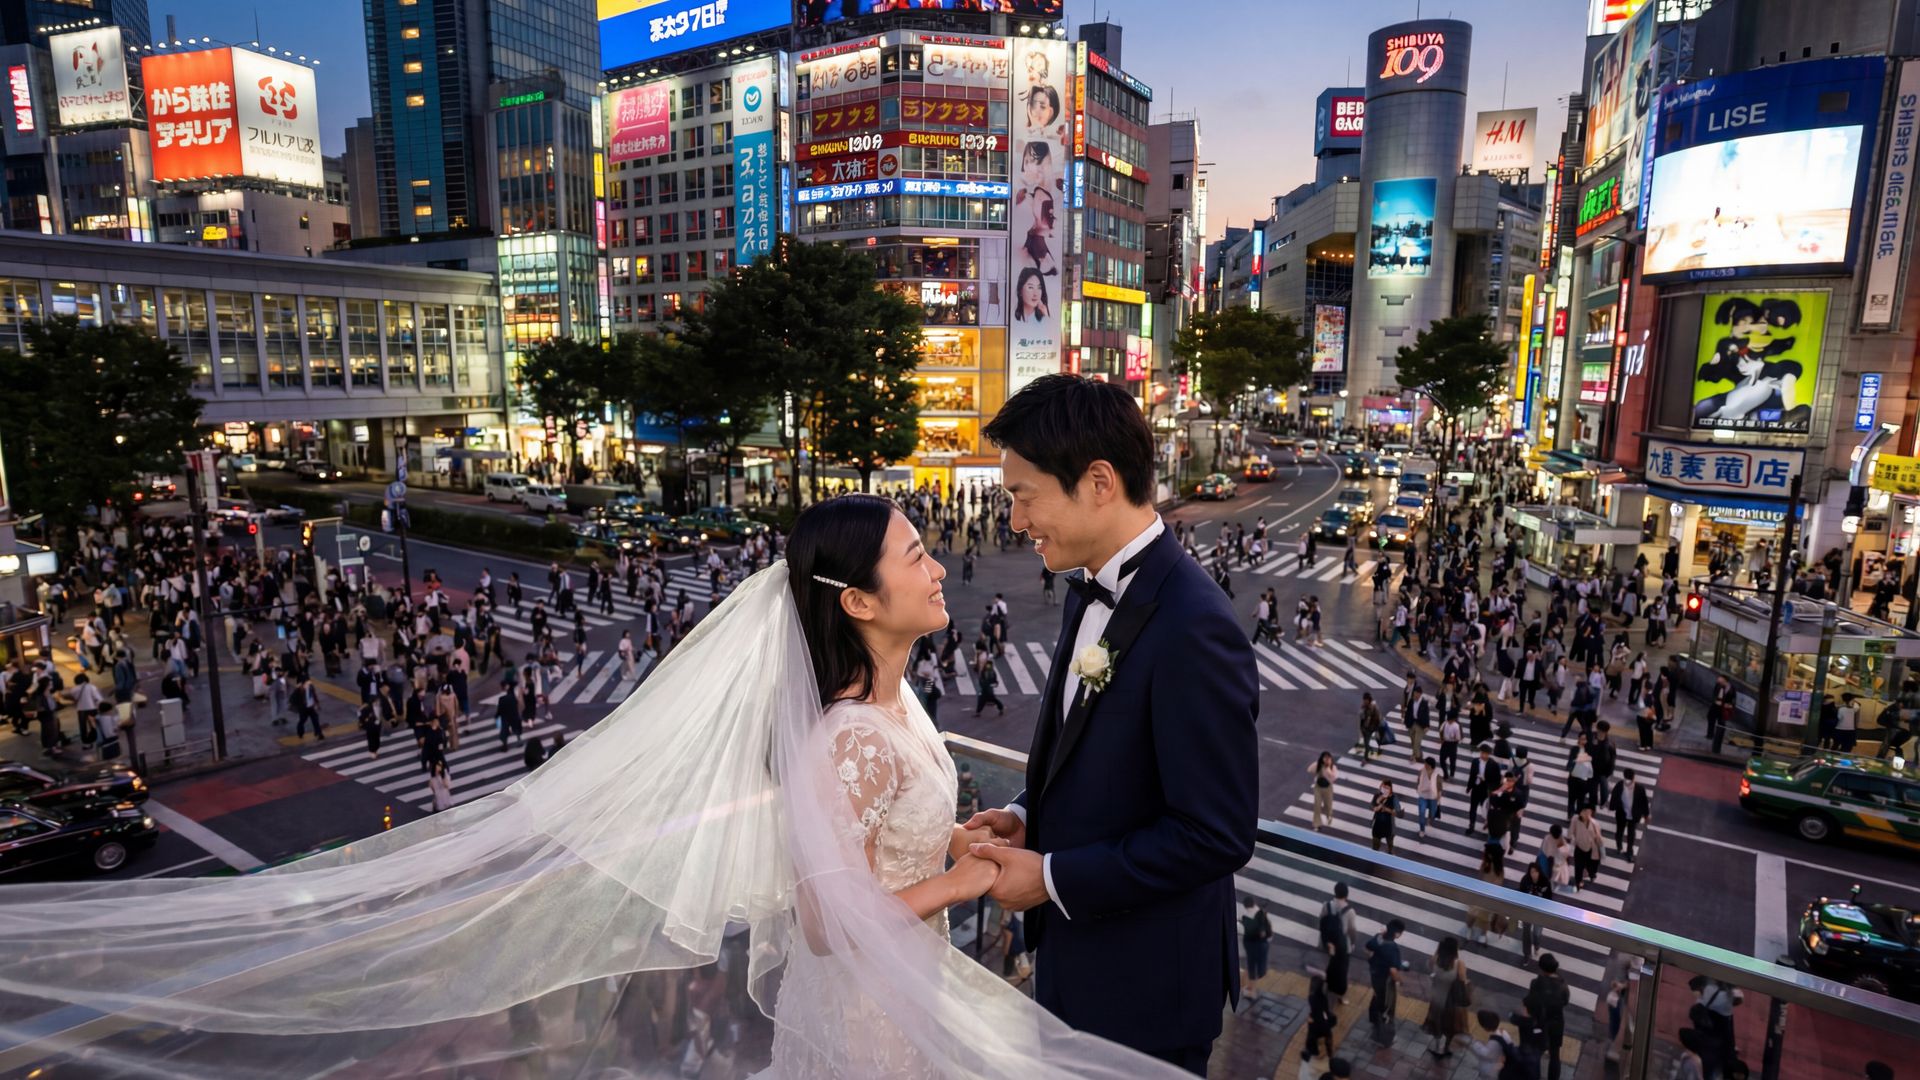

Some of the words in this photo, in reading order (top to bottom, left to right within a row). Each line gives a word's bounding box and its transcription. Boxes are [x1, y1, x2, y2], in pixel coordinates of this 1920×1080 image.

[1387, 33, 1445, 50] SHIBUYA
[1380, 44, 1445, 84] 109
[1708, 103, 1768, 132] LISE
